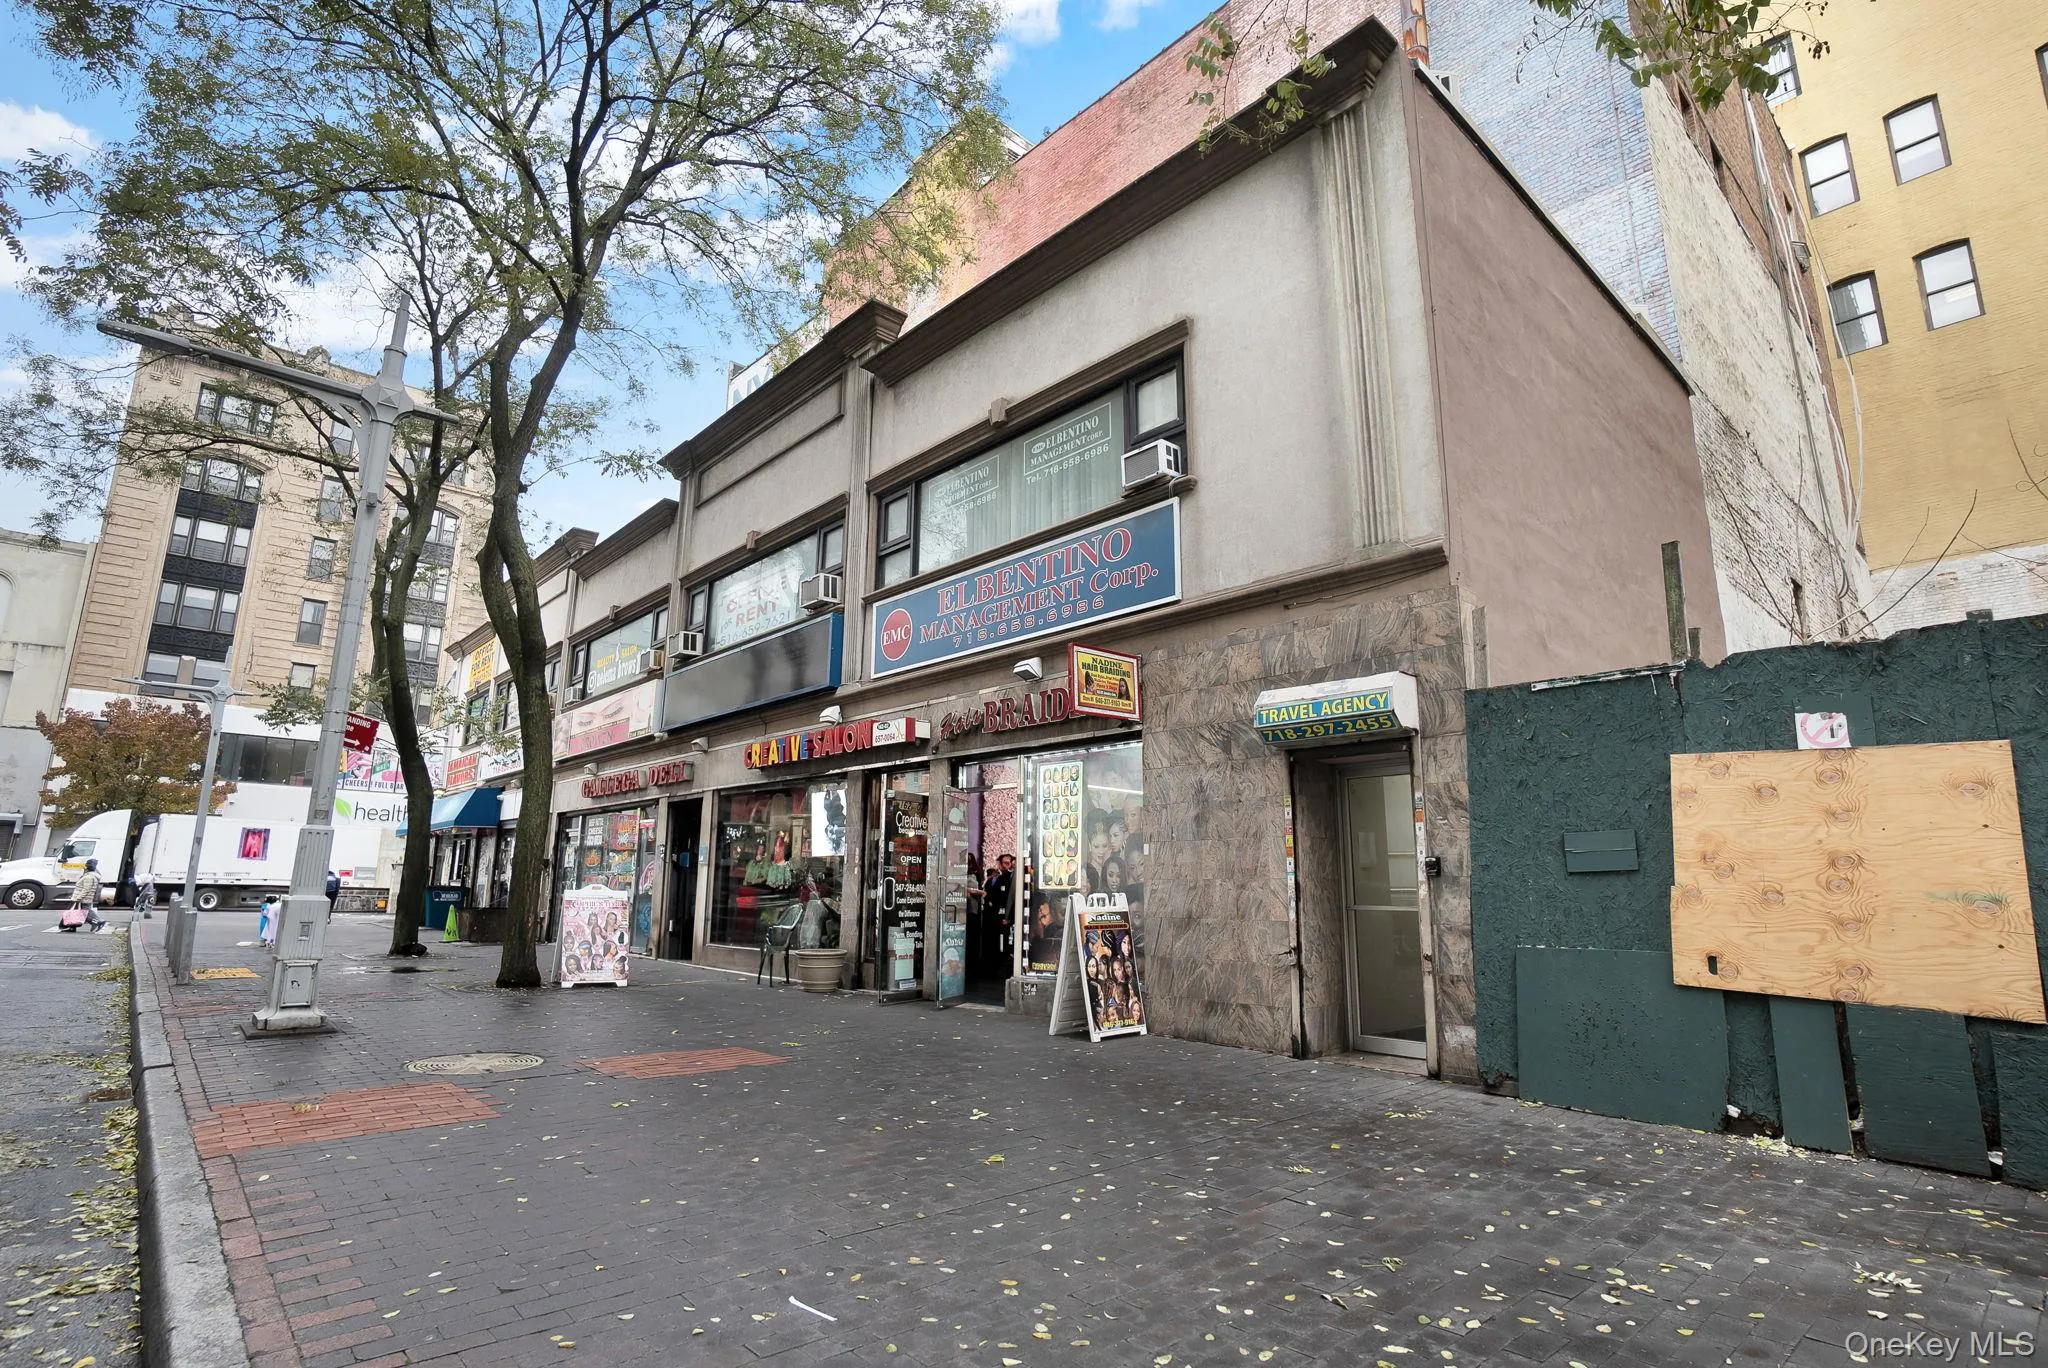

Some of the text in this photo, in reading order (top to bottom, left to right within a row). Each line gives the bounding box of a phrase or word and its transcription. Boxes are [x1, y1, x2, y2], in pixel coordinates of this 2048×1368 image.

[1046, 415, 1099, 449] ELBENTINO
[1030, 434, 1087, 467] MANAGEMENT
[1043, 443, 1110, 478] 718-658-6986
[937, 527, 1132, 617] ELBENTINO
[736, 600, 777, 627] RENT
[919, 560, 1159, 645] MANAGEMENT Corp.
[882, 622, 912, 647] EMC
[952, 594, 1105, 649] 718.658.6986
[1081, 661, 1099, 673] HAIR
[1099, 665, 1131, 679] BRAIDING
[1091, 656, 1124, 670] NADINE
[982, 686, 1080, 734] BRAID
[1260, 691, 1389, 724] TRAVEL AGENCY
[346, 716, 372, 729] ANDING
[1263, 715, 1393, 743] 718-297-2455
[743, 719, 873, 770] CREATIVE SALON
[374, 781, 388, 789] FULL
[647, 760, 687, 786] DELI
[895, 810, 928, 829] Creative
[900, 855, 922, 864] OPEN
[1089, 913, 1121, 921] Nadine
